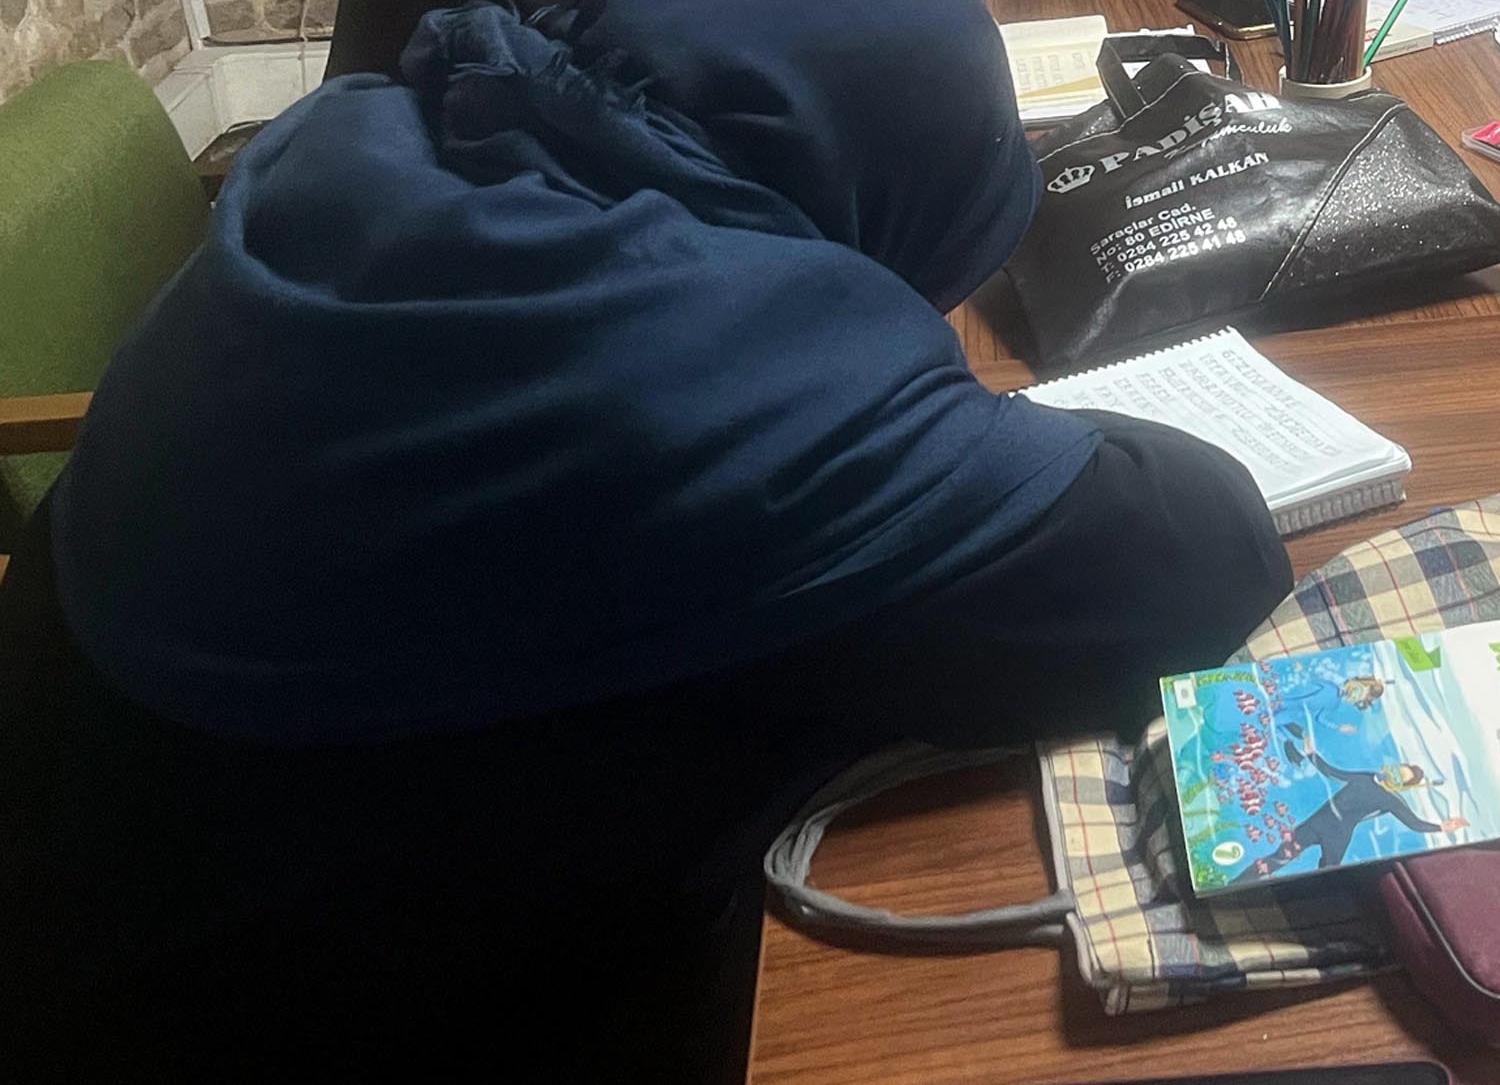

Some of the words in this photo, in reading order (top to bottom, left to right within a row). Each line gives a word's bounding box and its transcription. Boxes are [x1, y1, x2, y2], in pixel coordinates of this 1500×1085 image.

[1100, 92, 1282, 174] PADİŞAH
[1190, 152, 1269, 187] KALKAN
[1090, 216, 1154, 256] Saraçlar
[1157, 202, 1197, 221] Cad.
[1096, 243, 1122, 265] No:
[1124, 232, 1146, 247] 80
[1148, 207, 1216, 238] EDİRNE
[1116, 240, 1157, 262] 0284
[1159, 229, 1191, 248] 225
[1193, 222, 1215, 237] 42
[1217, 216, 1238, 231] 48
[1124, 250, 1165, 273] 0284
[1167, 241, 1199, 261] 225
[1201, 234, 1222, 251] 41
[1225, 229, 1247, 245] 48
